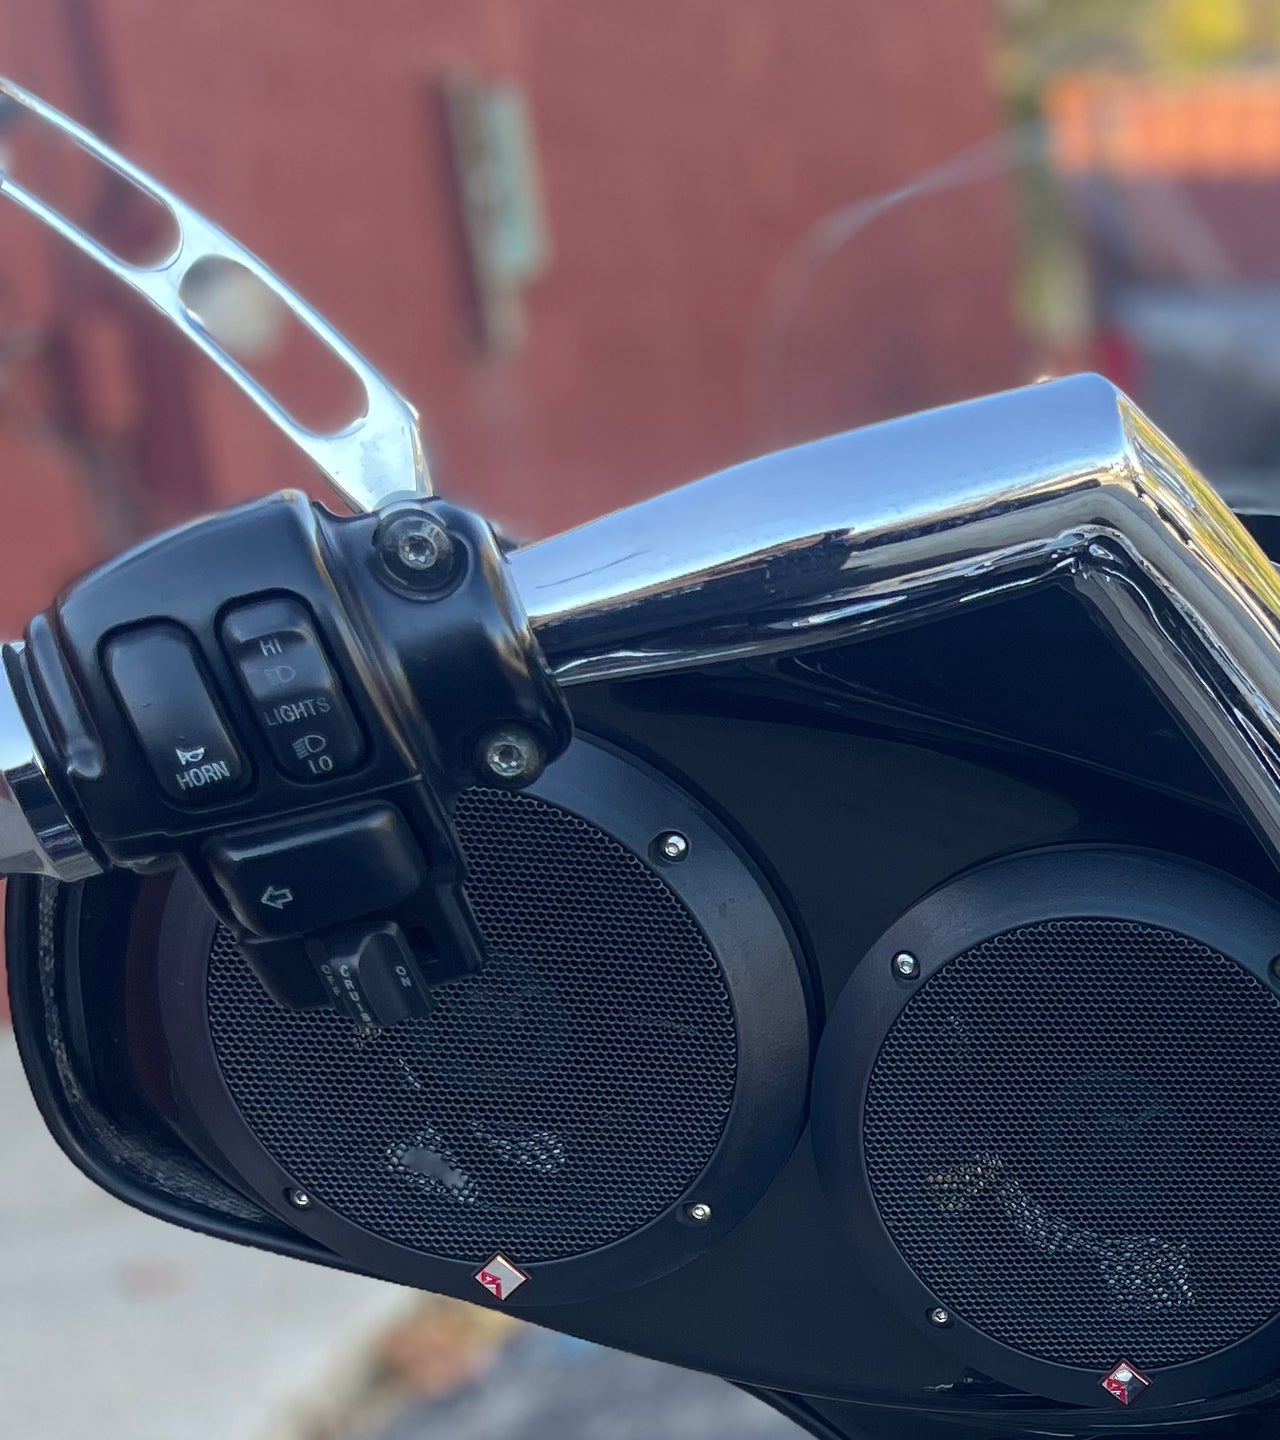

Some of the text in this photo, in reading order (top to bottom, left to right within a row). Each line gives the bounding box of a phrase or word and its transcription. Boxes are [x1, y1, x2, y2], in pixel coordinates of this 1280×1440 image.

[259, 638, 283, 657] HI
[263, 697, 331, 727] LIGHTS
[175, 760, 231, 791] HORN
[308, 755, 333, 775] LO
[395, 965, 412, 988] ON
